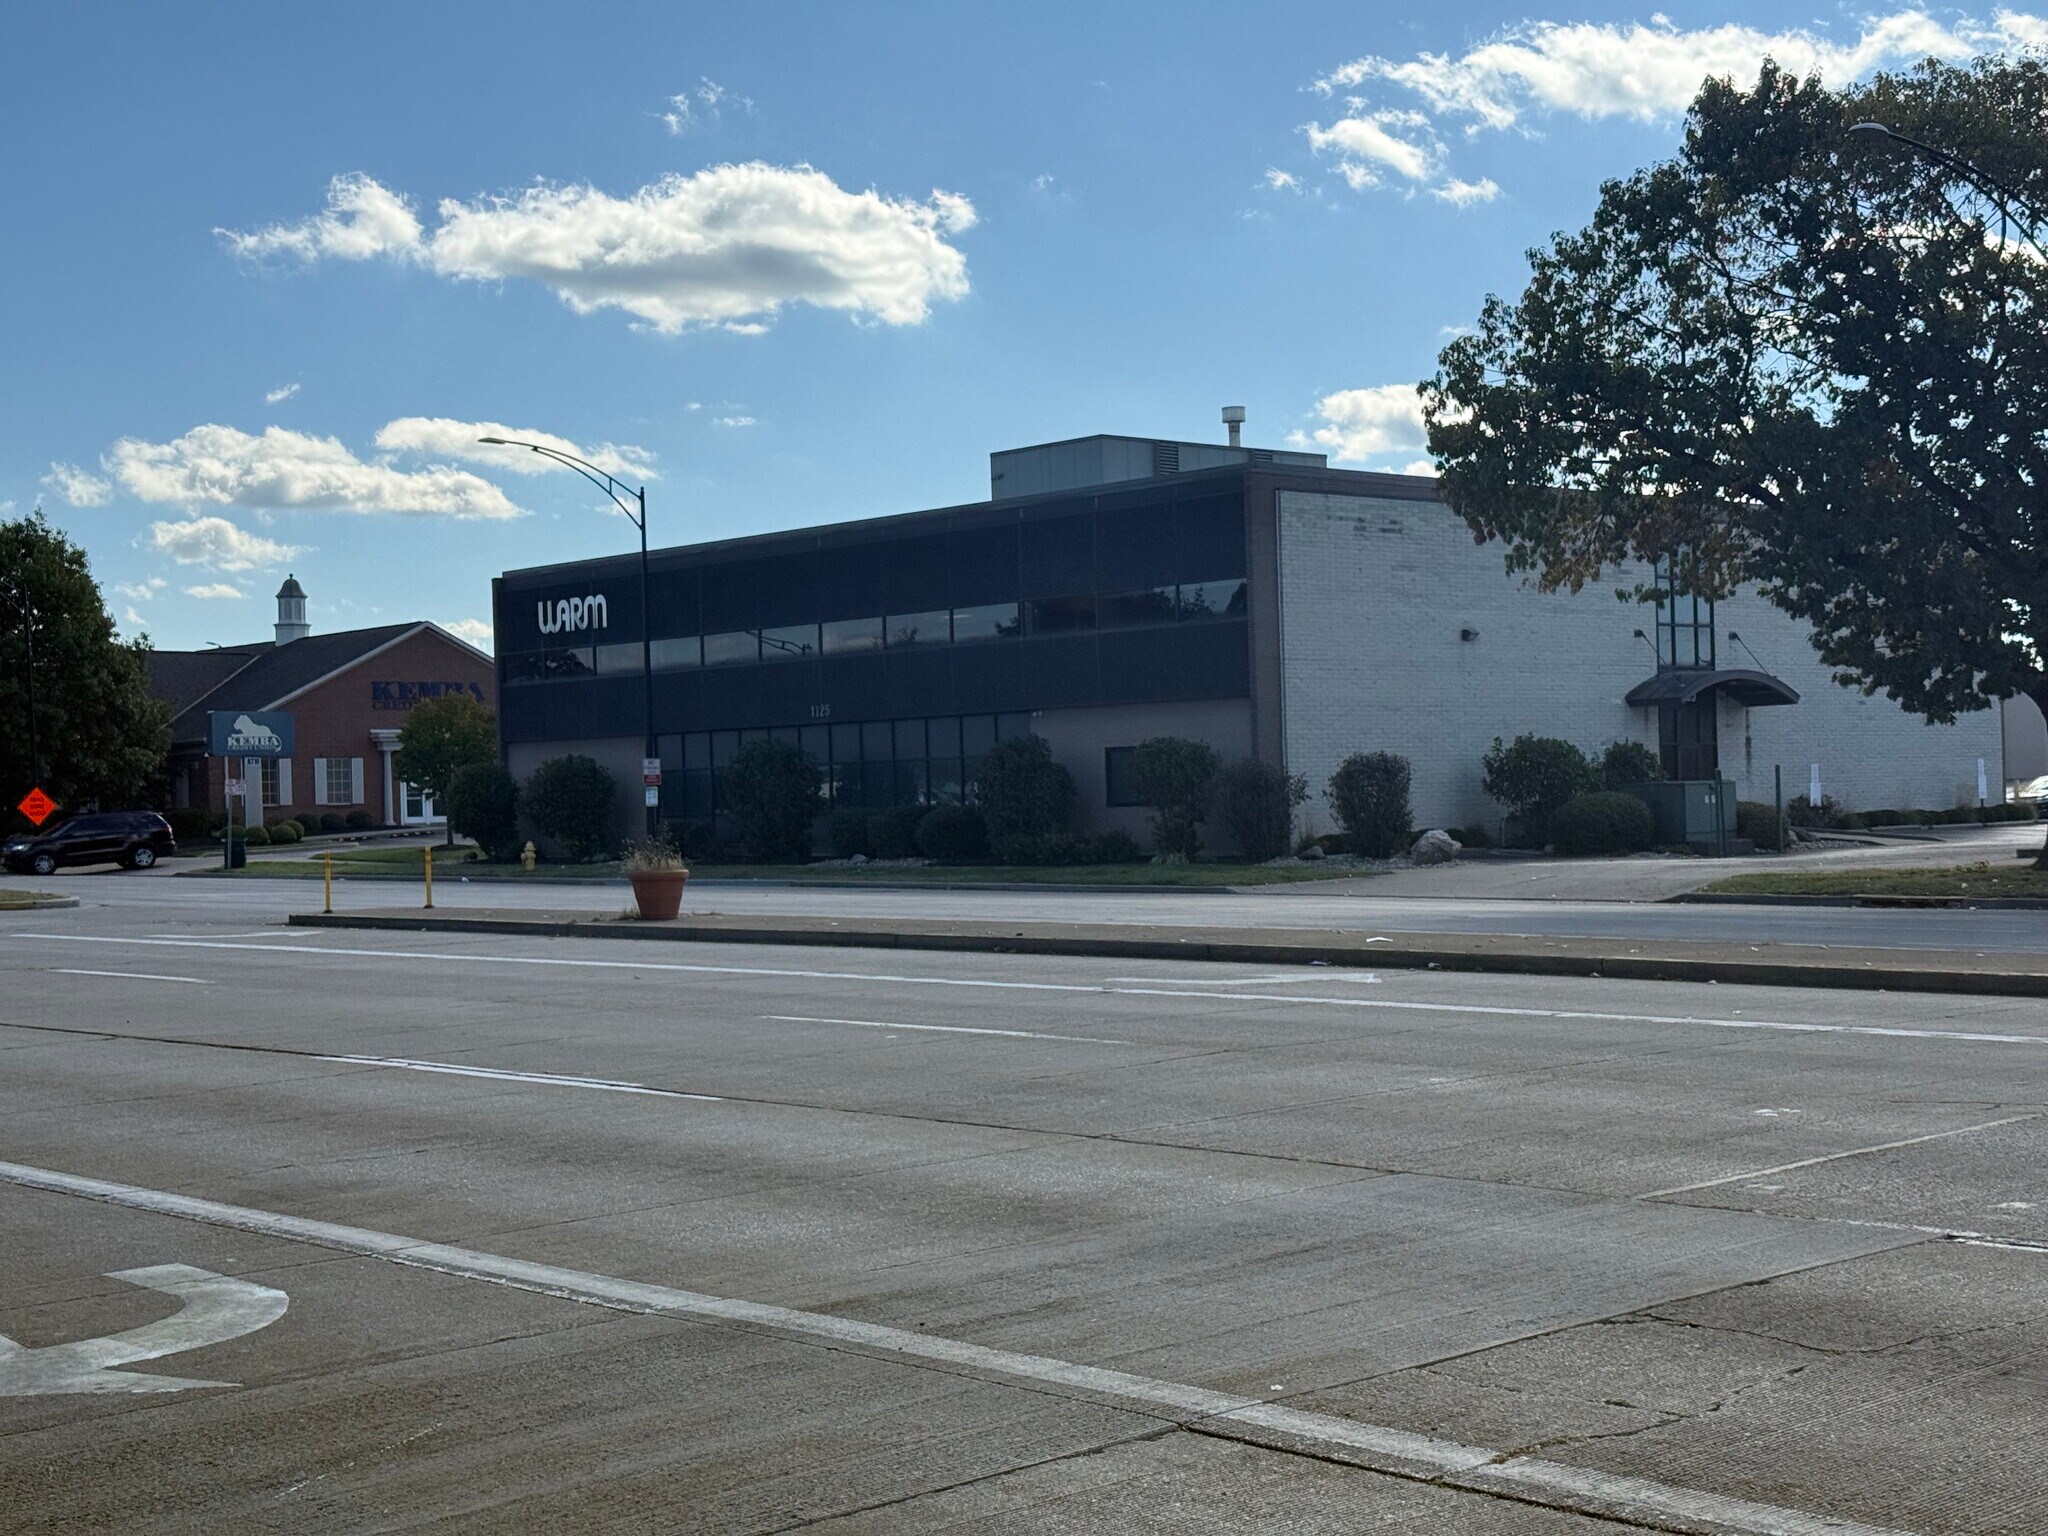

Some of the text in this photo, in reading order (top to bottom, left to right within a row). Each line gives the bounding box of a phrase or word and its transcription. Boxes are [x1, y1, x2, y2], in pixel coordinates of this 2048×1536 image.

[538, 594, 607, 634] WARM
[811, 704, 830, 718] 1125
[227, 736, 279, 746] KEMBA
